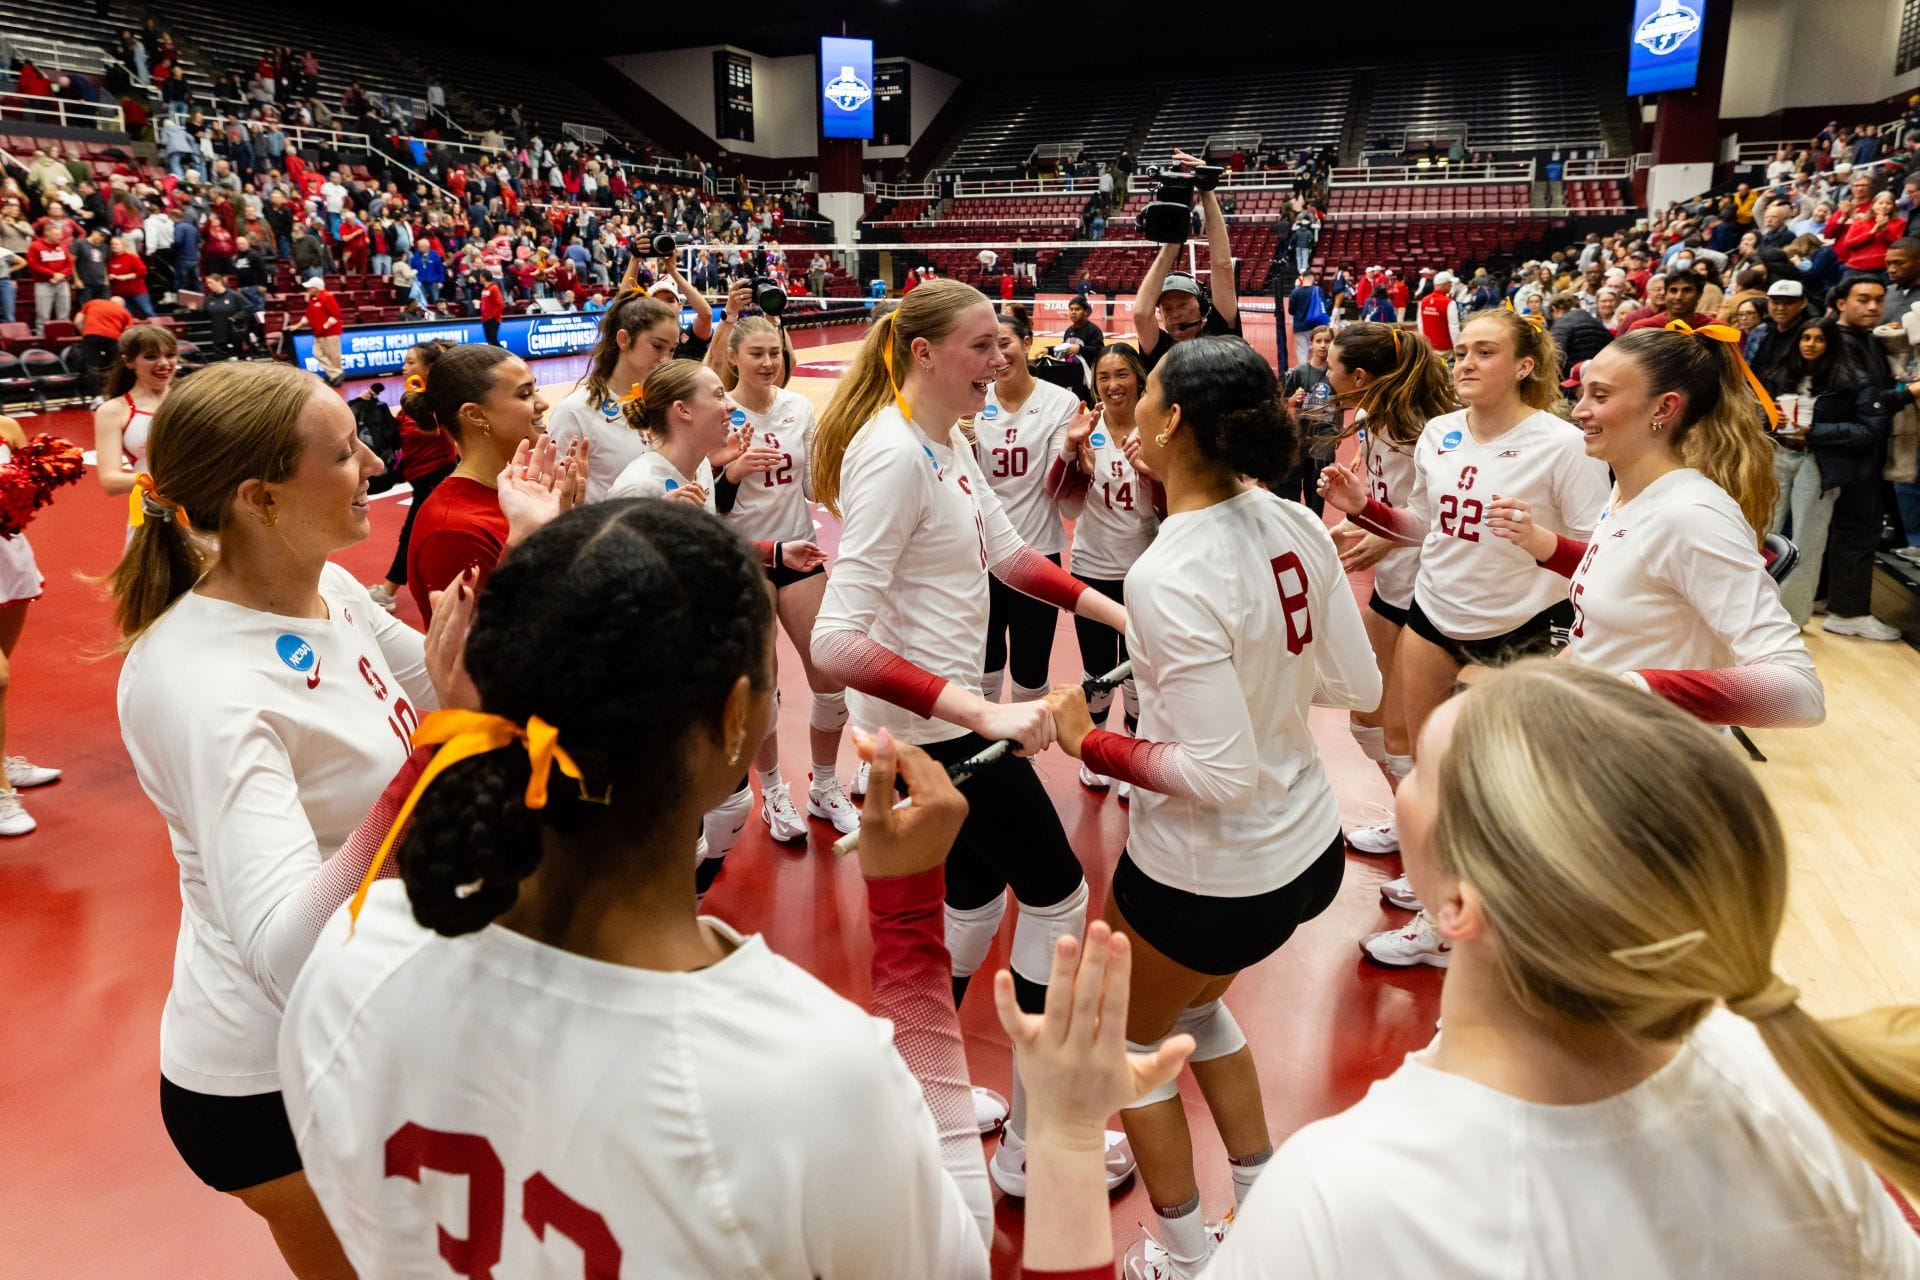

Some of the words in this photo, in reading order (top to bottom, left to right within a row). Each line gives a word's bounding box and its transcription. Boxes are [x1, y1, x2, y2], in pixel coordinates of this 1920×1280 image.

[352, 335, 384, 352] 2025
[386, 333, 415, 350] NCAA
[531, 329, 599, 350] CHAMPIONSH
[367, 349, 406, 367] VOLLEY
[763, 453, 793, 488] 12
[991, 446, 1028, 478] 30
[1102, 481, 1134, 512] 14
[1440, 494, 1483, 543] 22
[1270, 550, 1313, 656] 8
[289, 642, 312, 666] NCAA
